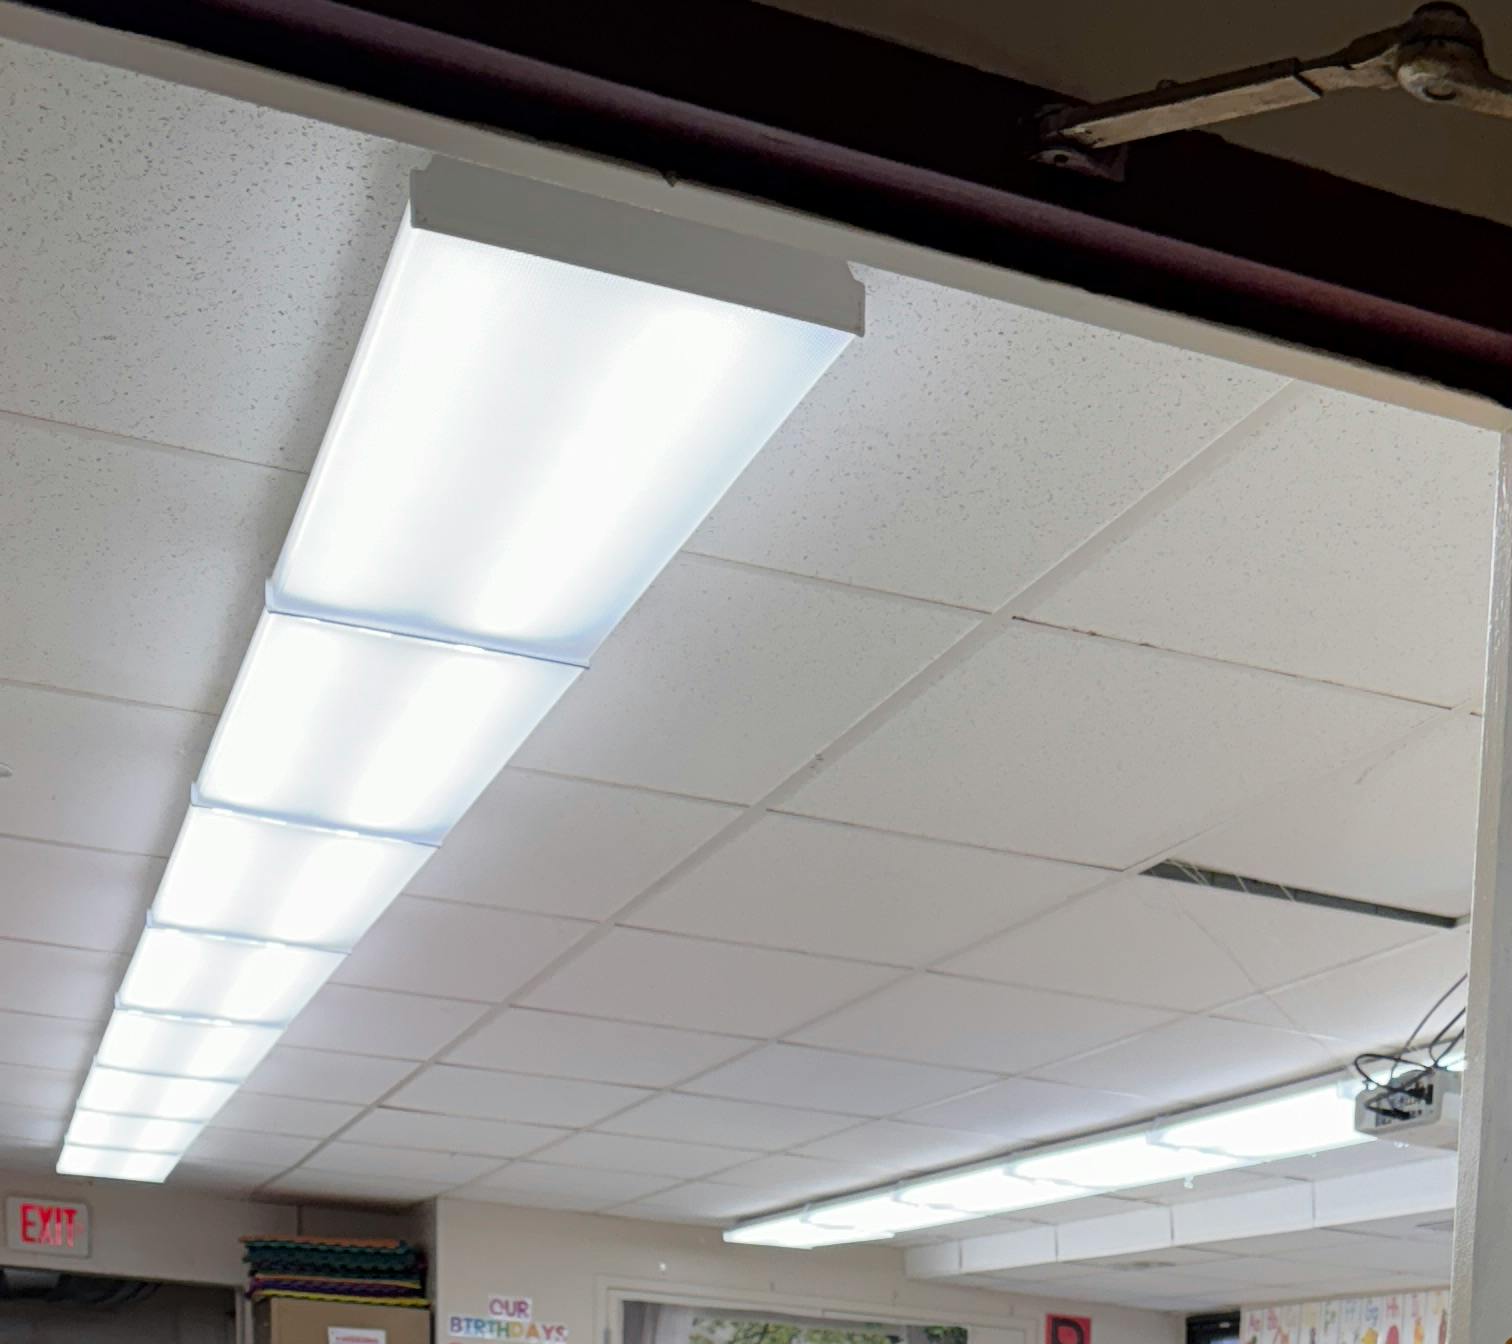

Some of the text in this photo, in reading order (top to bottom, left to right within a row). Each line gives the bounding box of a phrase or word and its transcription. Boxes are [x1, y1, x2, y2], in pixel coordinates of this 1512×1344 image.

[21, 1203, 78, 1248] EXIT
[488, 1298, 529, 1319] OUR
[450, 1316, 567, 1343] BIRTHDAYS
